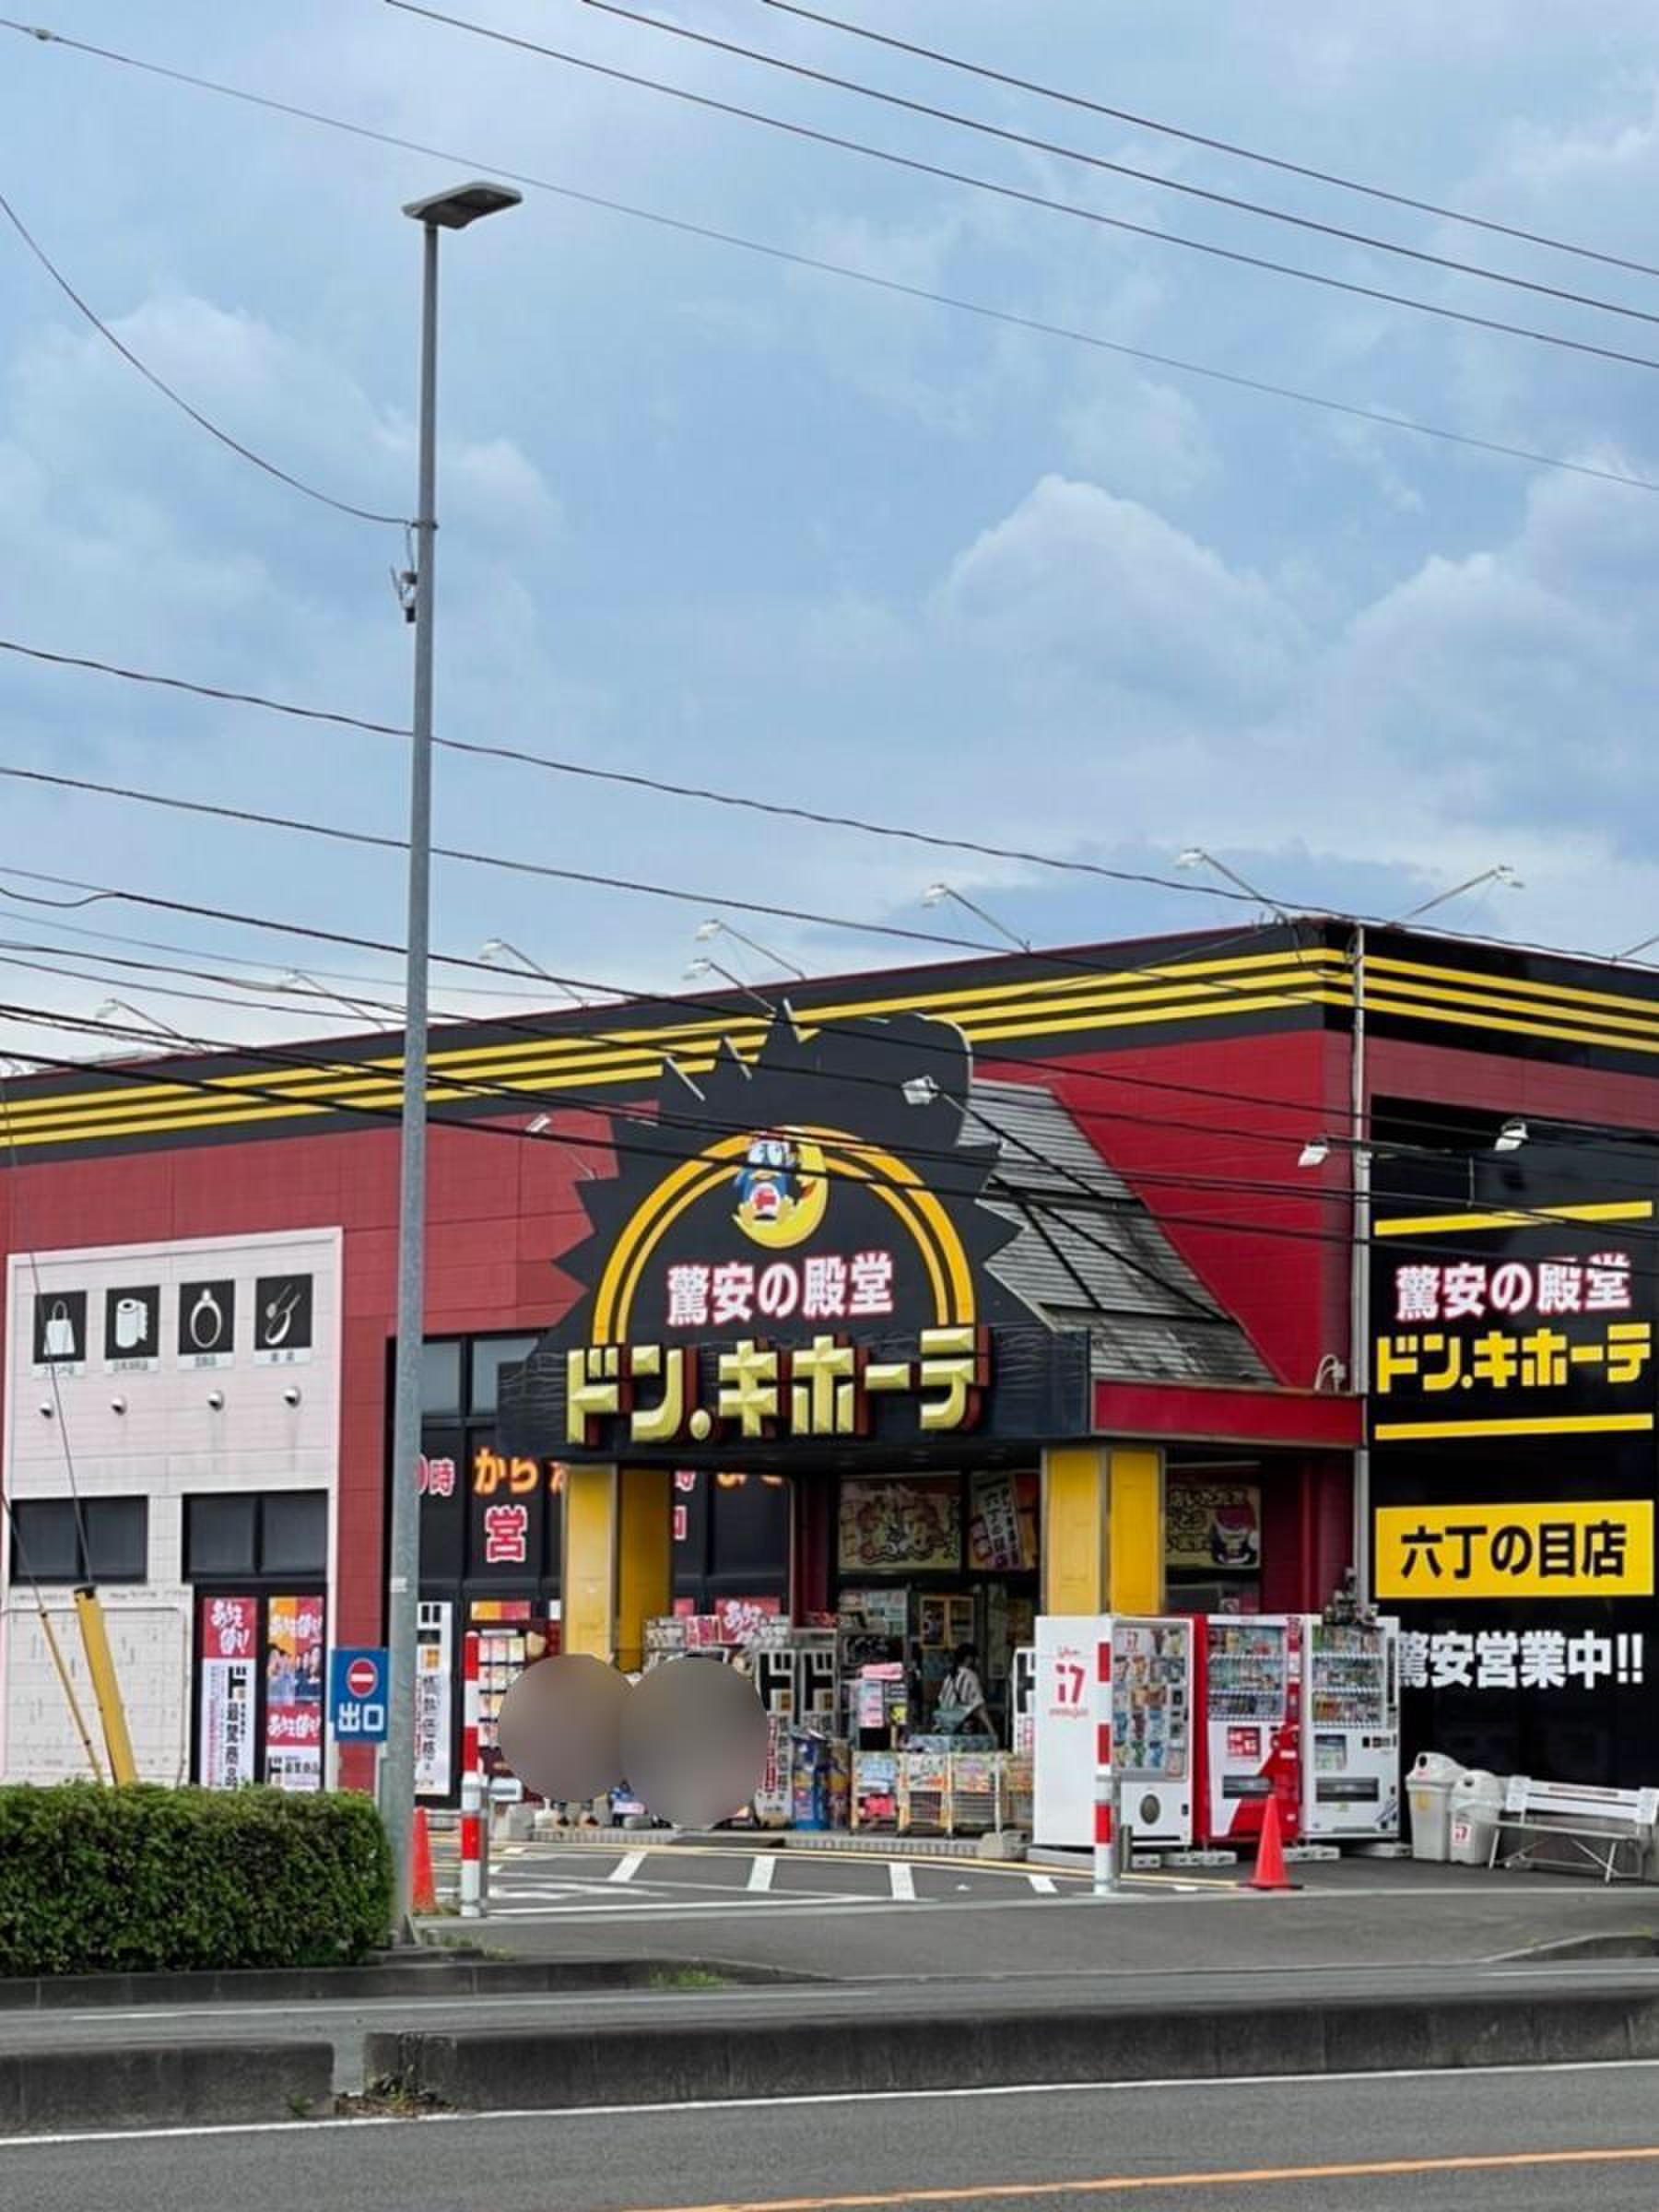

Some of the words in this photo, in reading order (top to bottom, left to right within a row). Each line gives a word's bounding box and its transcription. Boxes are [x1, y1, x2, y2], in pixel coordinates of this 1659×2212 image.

[666, 1252, 893, 1326] 驚安の殿堂
[1395, 1253, 1631, 1323] 驚安の殿堂
[1401, 1521, 1627, 1580] 六丁の目店
[338, 1702, 384, 1732] 出口
